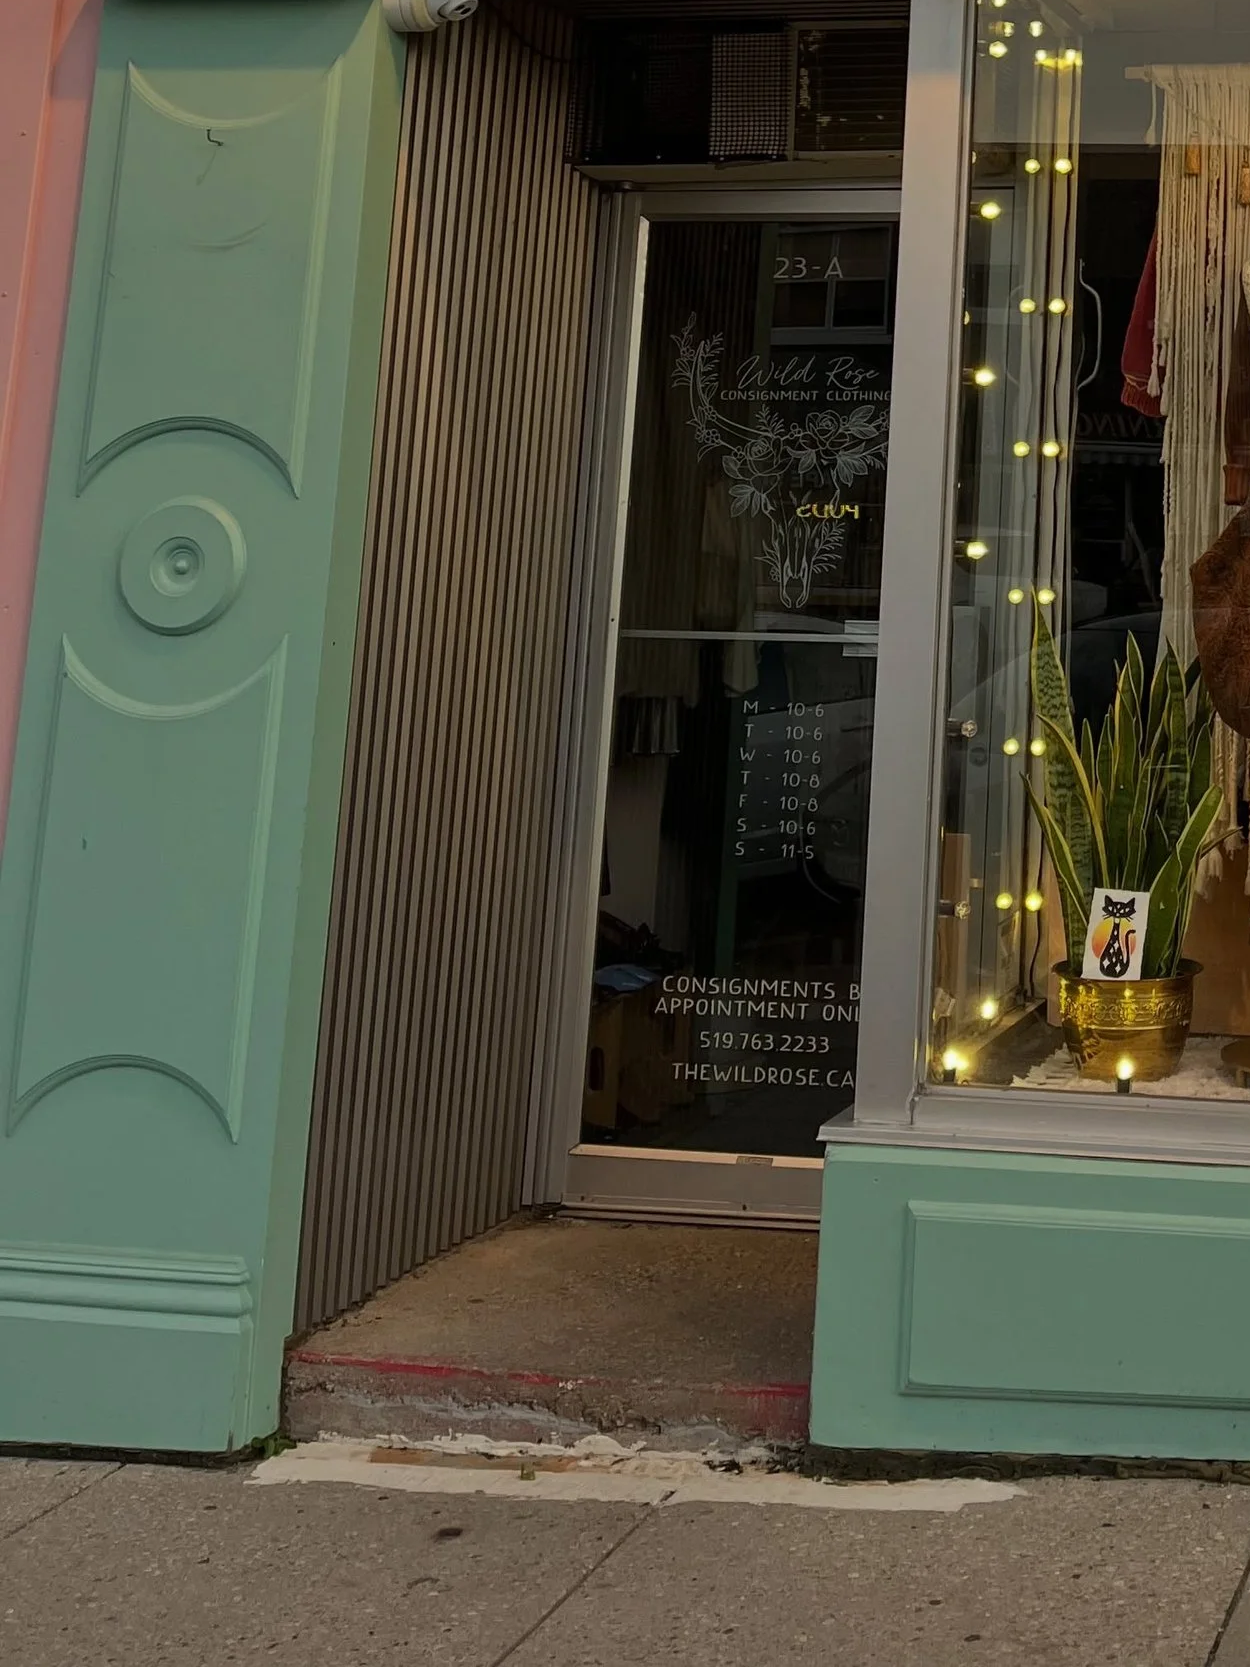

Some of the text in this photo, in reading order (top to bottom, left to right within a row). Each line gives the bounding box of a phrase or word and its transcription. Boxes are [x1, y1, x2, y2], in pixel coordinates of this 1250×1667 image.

[773, 256, 844, 279] 23-A
[736, 353, 880, 390] Wild Rose
[720, 389, 819, 402] CONSIGNMENT
[743, 700, 759, 714] M
[787, 702, 824, 717] 10-6
[744, 723, 755, 738] T
[785, 726, 822, 741] 10-6
[740, 747, 756, 762] W
[784, 749, 821, 765] 10-6
[740, 771, 751, 785] T
[782, 772, 820, 788] 10-8
[739, 794, 748, 808] F
[779, 796, 818, 812] 10-8
[736, 817, 748, 832] S
[778, 820, 816, 835] 10-6
[734, 841, 745, 856] S
[781, 843, 814, 859] 11-5
[662, 975, 861, 1001] CONSIGNMENTS B
[654, 997, 860, 1022] APPOINTMENT ONL
[700, 1031, 830, 1053] 519.763.2233
[672, 1062, 855, 1088] THEWILDROSE.CA
